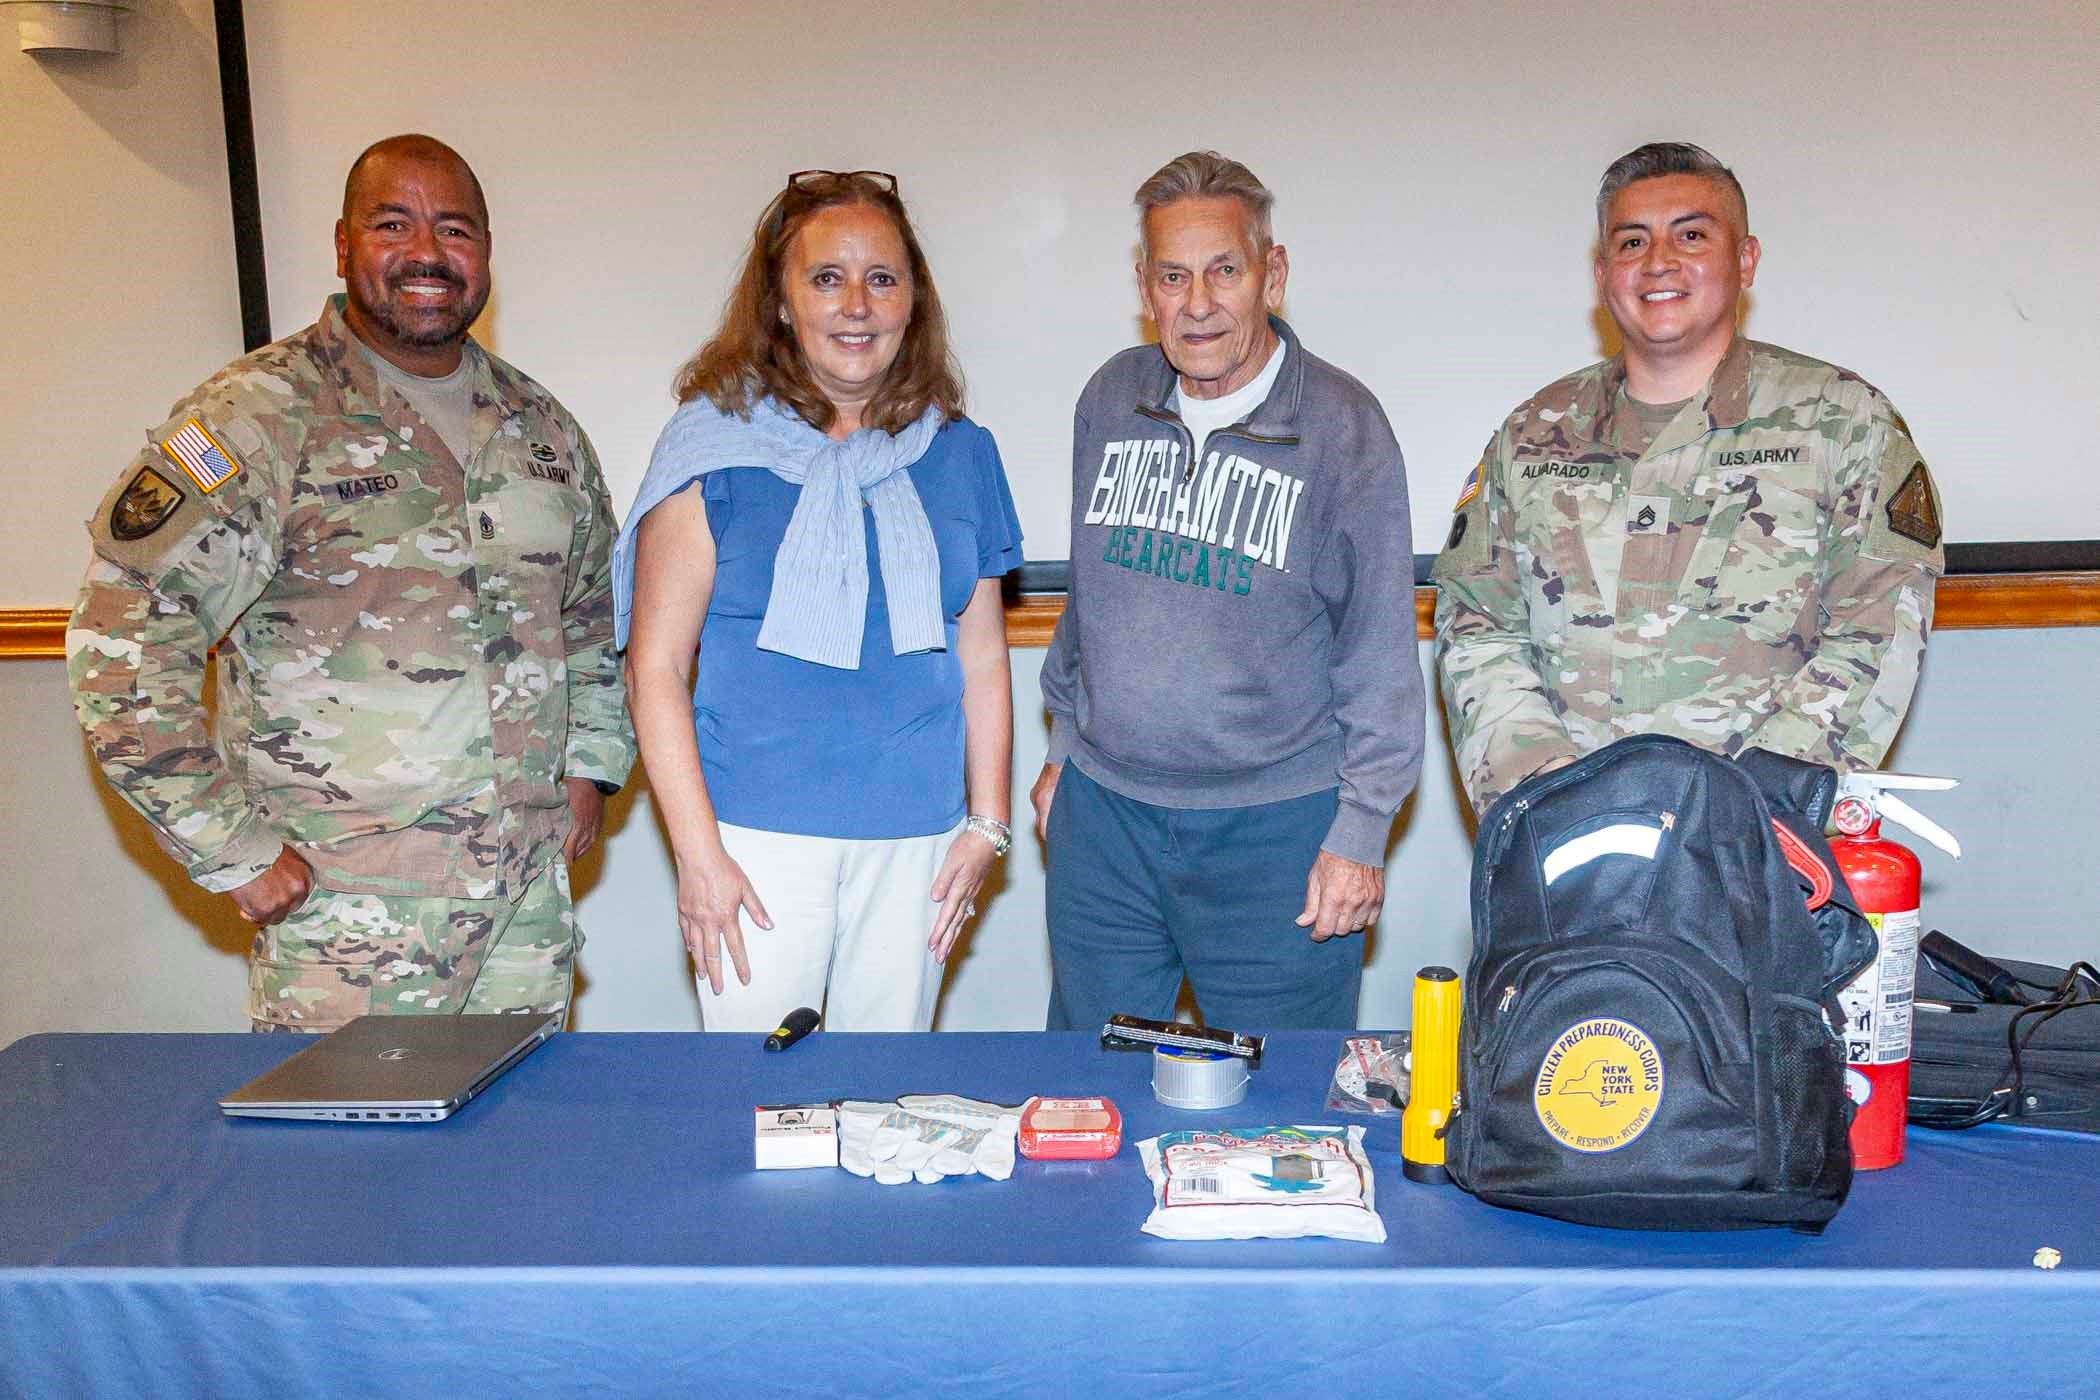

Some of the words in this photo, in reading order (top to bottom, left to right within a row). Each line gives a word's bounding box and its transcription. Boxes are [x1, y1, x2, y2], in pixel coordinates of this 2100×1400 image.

[1719, 451, 1748, 466] U.S.
[1752, 447, 1800, 464] ARMY
[336, 474, 399, 500] MATEO
[1084, 439, 1305, 571] BINGHAMTON
[1103, 526, 1255, 596] BEARCATS
[1537, 1050, 1563, 1096] CITIZEN
[1559, 1022, 1646, 1053] PREPAREDNESS
[1640, 1048, 1659, 1092] CORPS
[1602, 1065, 1628, 1074] NEW
[1601, 1085, 1635, 1095] STATE
[1602, 1075, 1633, 1084] YORK
[1544, 1110, 1570, 1141] PREPARE
[1576, 1135, 1615, 1147] RESPOND
[1620, 1106, 1651, 1139] RECOVER
